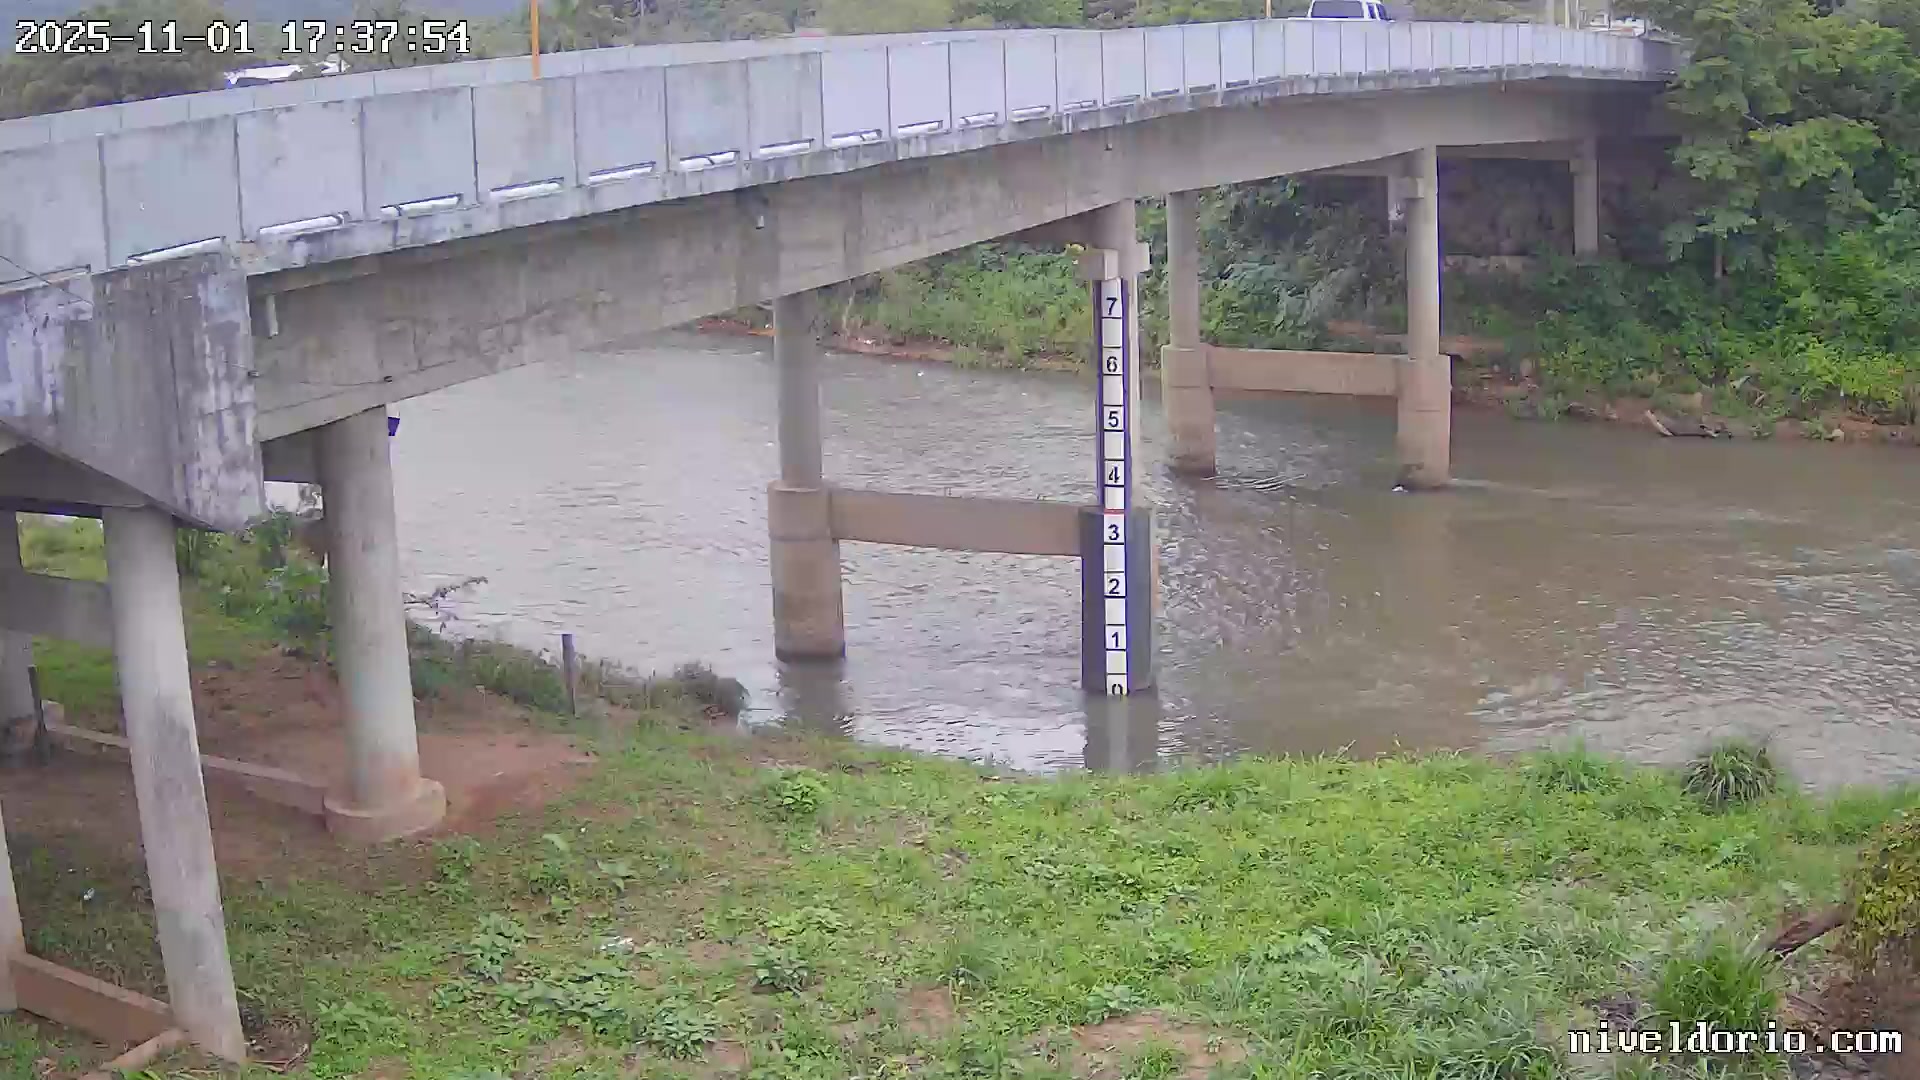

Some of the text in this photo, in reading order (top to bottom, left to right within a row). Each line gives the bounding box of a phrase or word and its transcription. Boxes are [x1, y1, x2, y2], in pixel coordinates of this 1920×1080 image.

[1106, 297, 1118, 315] 7
[1106, 356, 1118, 372] 6
[1108, 411, 1119, 427] 5
[1108, 466, 1120, 484] 4
[1108, 524, 1119, 541] 3
[1108, 578, 1120, 595] 2
[1111, 632, 1119, 648] 1
